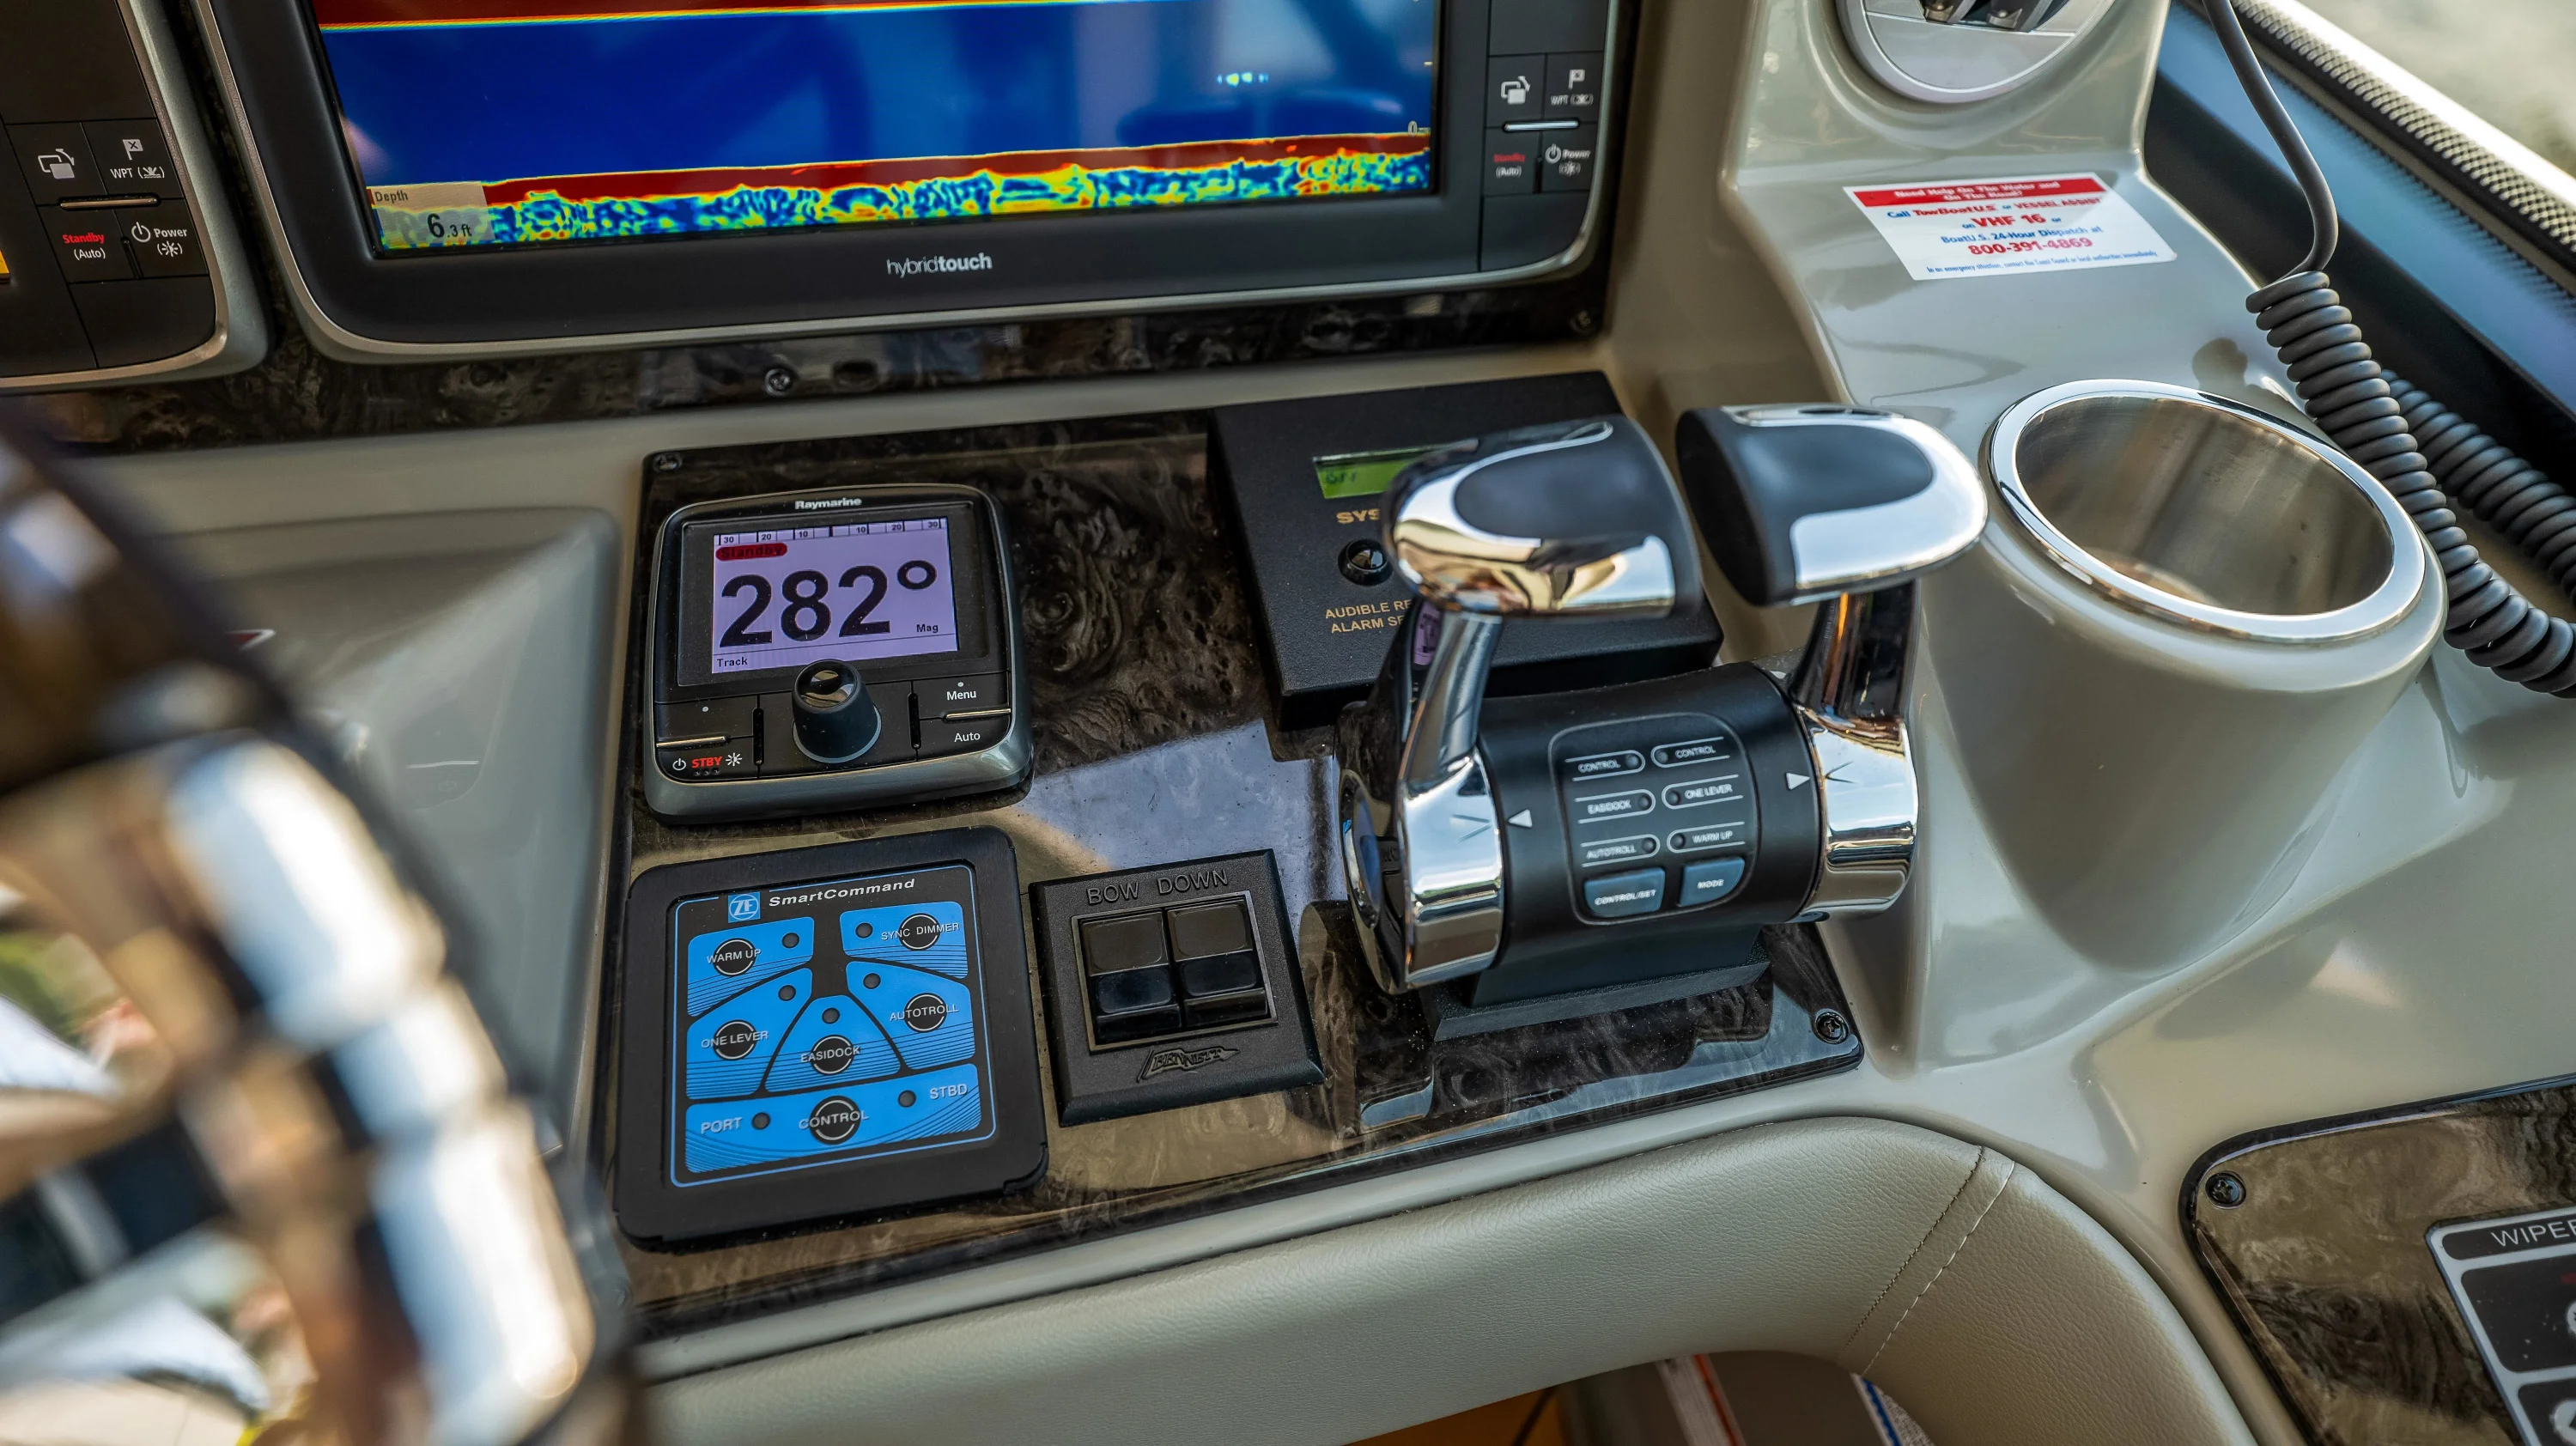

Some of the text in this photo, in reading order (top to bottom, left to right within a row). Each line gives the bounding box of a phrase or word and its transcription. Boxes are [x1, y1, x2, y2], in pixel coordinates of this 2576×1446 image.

[1562, 149, 1590, 158] Power
[110, 167, 133, 179] WPT
[375, 189, 409, 204] Depth
[2013, 200, 2060, 210] VESSEL
[1971, 214, 2016, 228] VHF
[2021, 213, 2046, 224] 16
[62, 232, 105, 245] Standby
[154, 228, 188, 239] Power
[1991, 230, 2036, 240] 24-Hour
[2038, 226, 2088, 238] Dispatch
[74, 247, 106, 260] (Auto)
[886, 252, 993, 278] hybridtouch
[794, 496, 862, 510] Raymarine
[1336, 508, 1381, 524] SYS
[723, 536, 734, 544] 30
[761, 532, 772, 541] 20
[799, 530, 809, 538] 10
[891, 523, 902, 532] 20
[927, 520, 939, 529] 30
[721, 544, 782, 558] Standby
[720, 559, 938, 648] 282°
[1325, 602, 1391, 619] AUDIBLE
[916, 622, 939, 635] Mag
[1331, 617, 1384, 634] ALARM
[717, 656, 748, 667] Track
[946, 689, 977, 701] Menu
[954, 731, 981, 742] Auto
[1675, 745, 1716, 759] CONTROL
[691, 756, 723, 769] STBY
[1577, 759, 1621, 773] CONTROL
[1684, 783, 1734, 799] ONE LEVER
[1692, 829, 1734, 844] WARM UP
[1586, 844, 1637, 860] AUTOTROLL
[1086, 868, 1229, 905] BOW DOWN
[1697, 878, 1724, 890] MODE
[769, 878, 915, 907] SmartCommand
[1595, 889, 1657, 906] CONTROL/SET
[881, 922, 960, 941] SYNC DIMMER
[707, 948, 762, 964] WARM UP
[890, 1004, 960, 1022] AUTOTROLL
[701, 1030, 769, 1048] ONE LEVER
[800, 1045, 861, 1063] EASIDOCK
[1152, 1048, 1223, 1068] BENNETT
[701, 1083, 969, 1133] PORT CONTROL STBD
